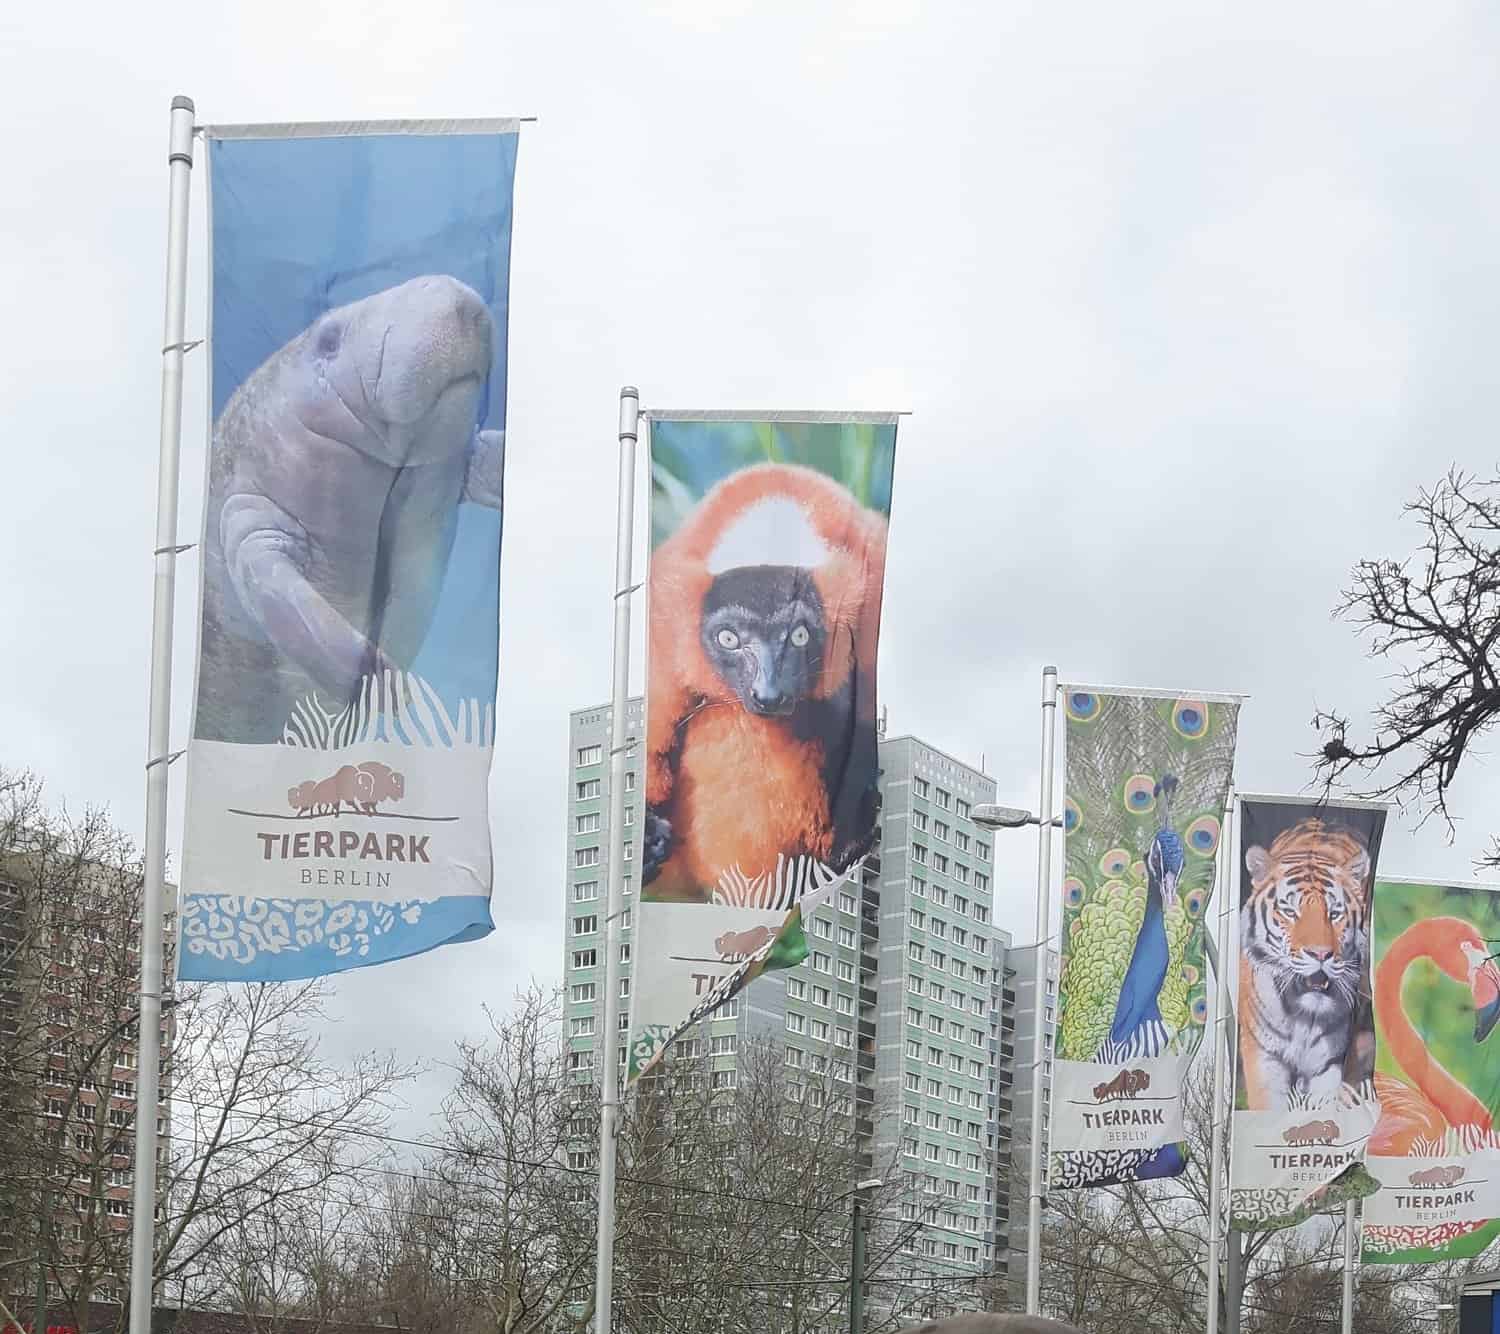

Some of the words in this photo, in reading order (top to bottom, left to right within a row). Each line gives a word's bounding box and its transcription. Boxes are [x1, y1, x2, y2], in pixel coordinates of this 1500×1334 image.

[256, 830, 431, 863] TIERPARK
[300, 868, 391, 887] BERLIN
[1082, 1108, 1165, 1128] TIERPARK
[1108, 1130, 1148, 1141] BERLIN
[1269, 1148, 1356, 1168] TIERPARK
[1394, 1189, 1475, 1208] TIERPARK
[1416, 1208, 1457, 1220] BERLIN
